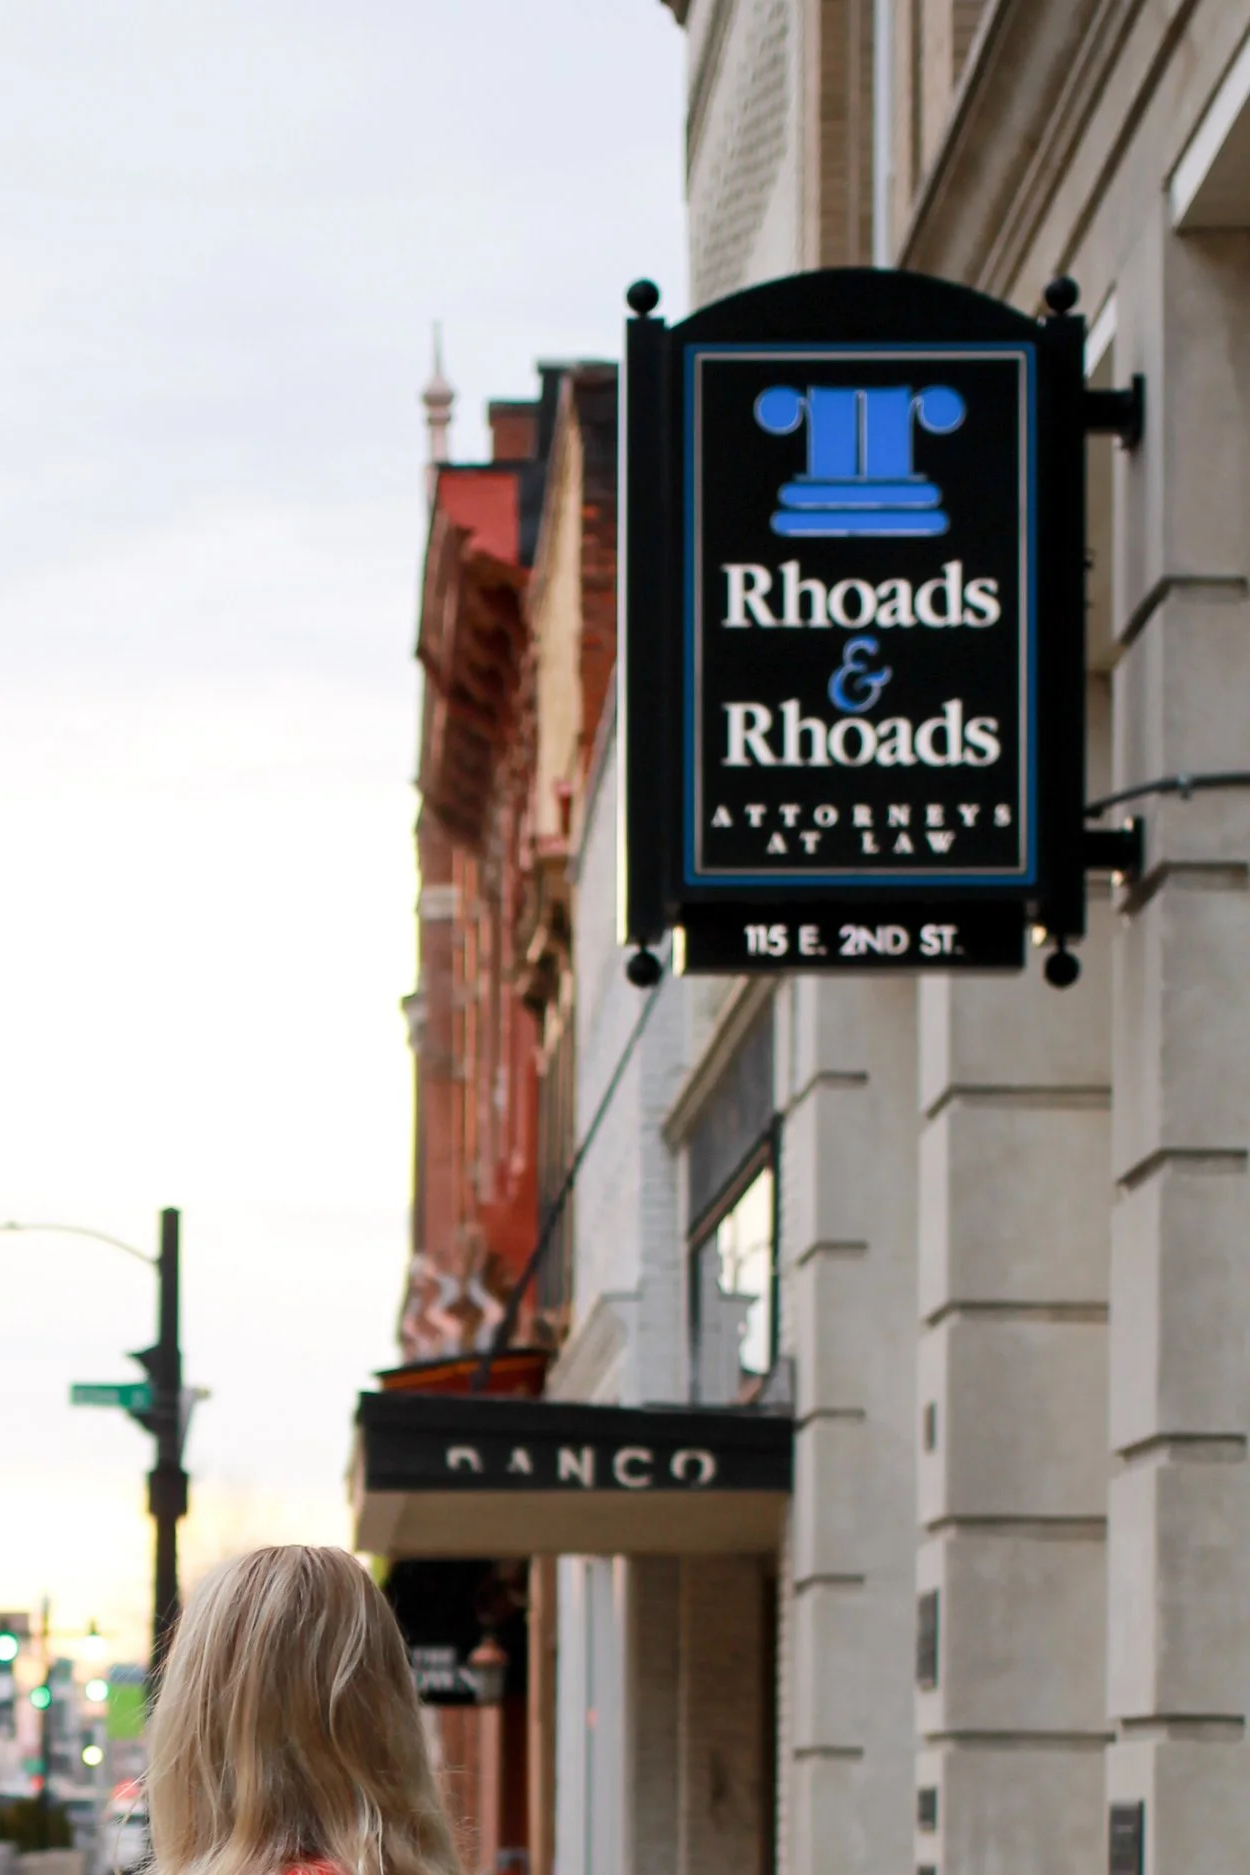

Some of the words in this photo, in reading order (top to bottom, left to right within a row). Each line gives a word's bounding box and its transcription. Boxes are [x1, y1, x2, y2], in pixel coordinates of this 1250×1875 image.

[721, 559, 1001, 629] Rhoads
[828, 634, 893, 713] &
[721, 698, 1001, 768] Rhoads
[711, 803, 1012, 827] ATTORNEYS
[766, 830, 821, 854] AT
[861, 830, 955, 854] LAW
[744, 923, 789, 957] 115
[798, 923, 827, 957] E.
[838, 923, 910, 957] 2ND
